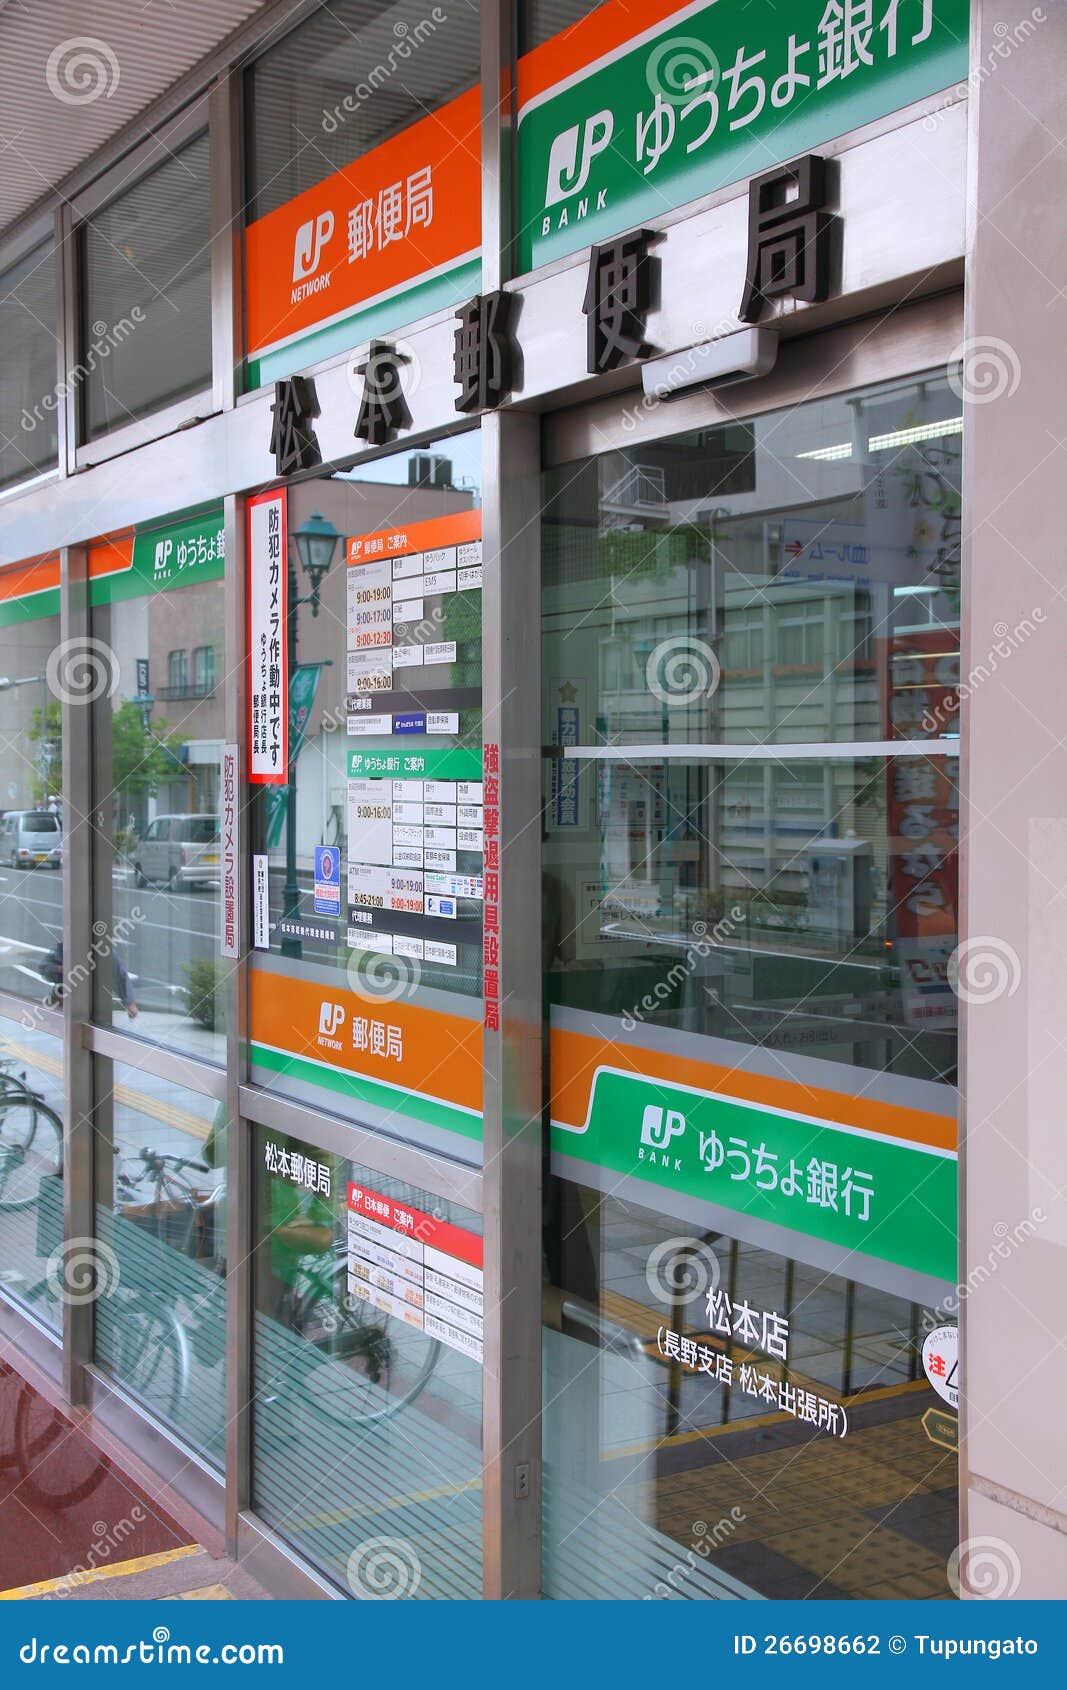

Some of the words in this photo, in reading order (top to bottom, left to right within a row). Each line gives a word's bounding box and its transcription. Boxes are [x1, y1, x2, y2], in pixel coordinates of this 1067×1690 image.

[544, 108, 614, 209] JP
[293, 210, 335, 282] JP
[346, 165, 434, 263] 郵便局
[541, 188, 609, 237] BANK
[270, 154, 842, 476] 松本郵便局
[290, 272, 331, 304] NETWORK
[268, 508, 280, 767] 防犯カメラ作動中です
[403, 757, 425, 771] ご案内
[223, 753, 236, 949] 防犯カメラ設置局
[482, 742, 500, 1032] 強盗撃退用具設置局
[317, 1036, 343, 1052] NETWORK
[319, 1001, 345, 1036] JP
[352, 1016, 403, 1062] 郵便局
[264, 1141, 331, 1198] 松本郵便局
[638, 1149, 683, 1171] BANK
[641, 1104, 686, 1149] JP
[699, 1130, 875, 1221] ゆうちょ銀行
[705, 1286, 789, 1360] 松本店
[929, 1353, 946, 1377] 注
